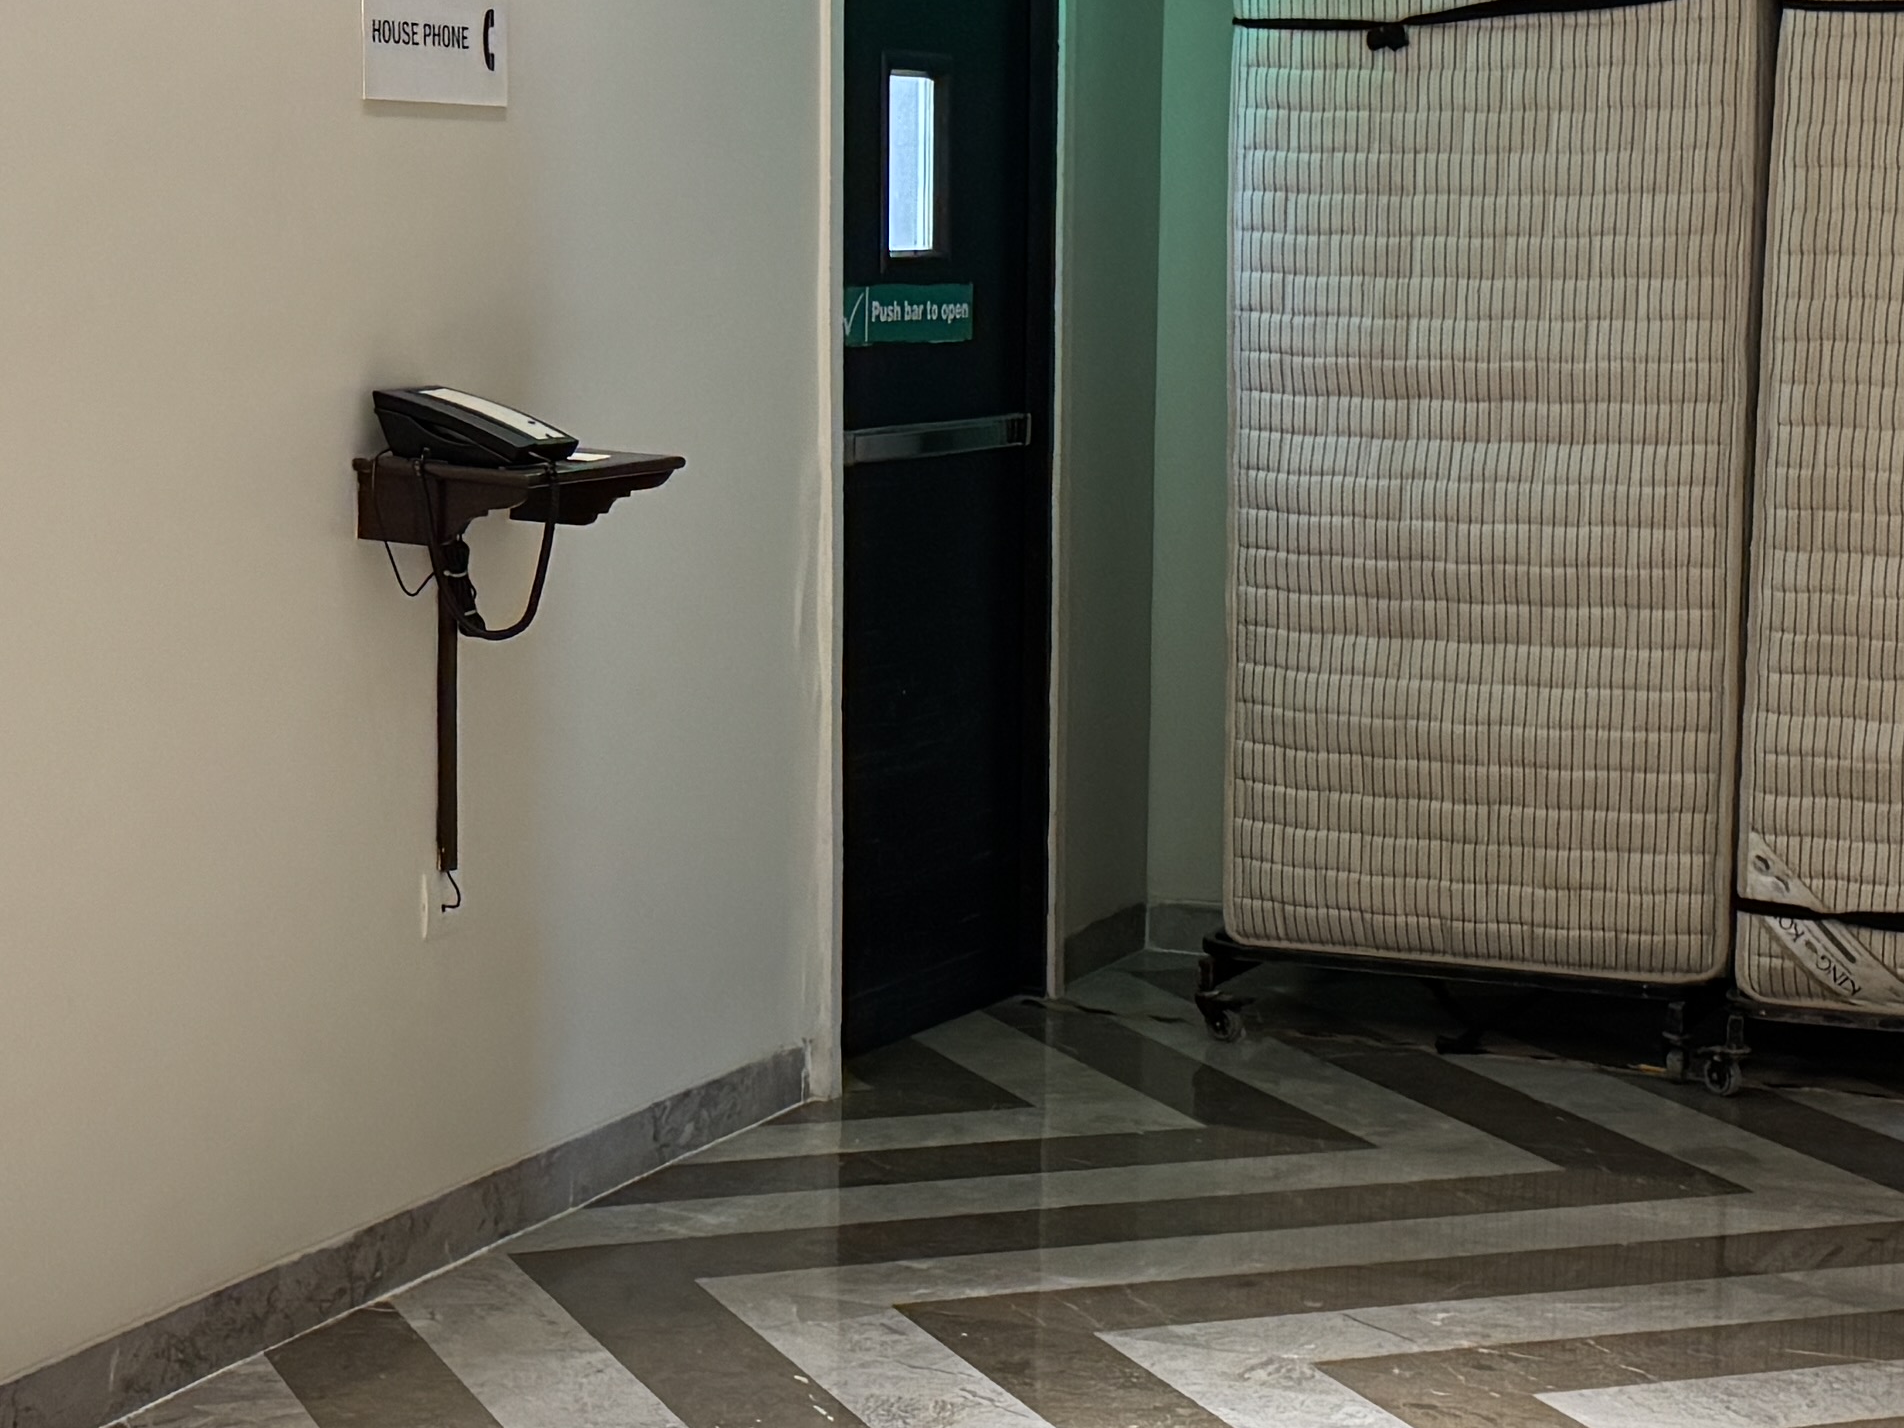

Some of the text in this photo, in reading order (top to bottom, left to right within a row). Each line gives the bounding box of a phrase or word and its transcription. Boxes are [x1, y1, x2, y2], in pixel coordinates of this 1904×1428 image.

[371, 19, 470, 49] HOUSE PHONE
[871, 300, 969, 324] Push bar to open
[1816, 955, 1862, 996] KING
